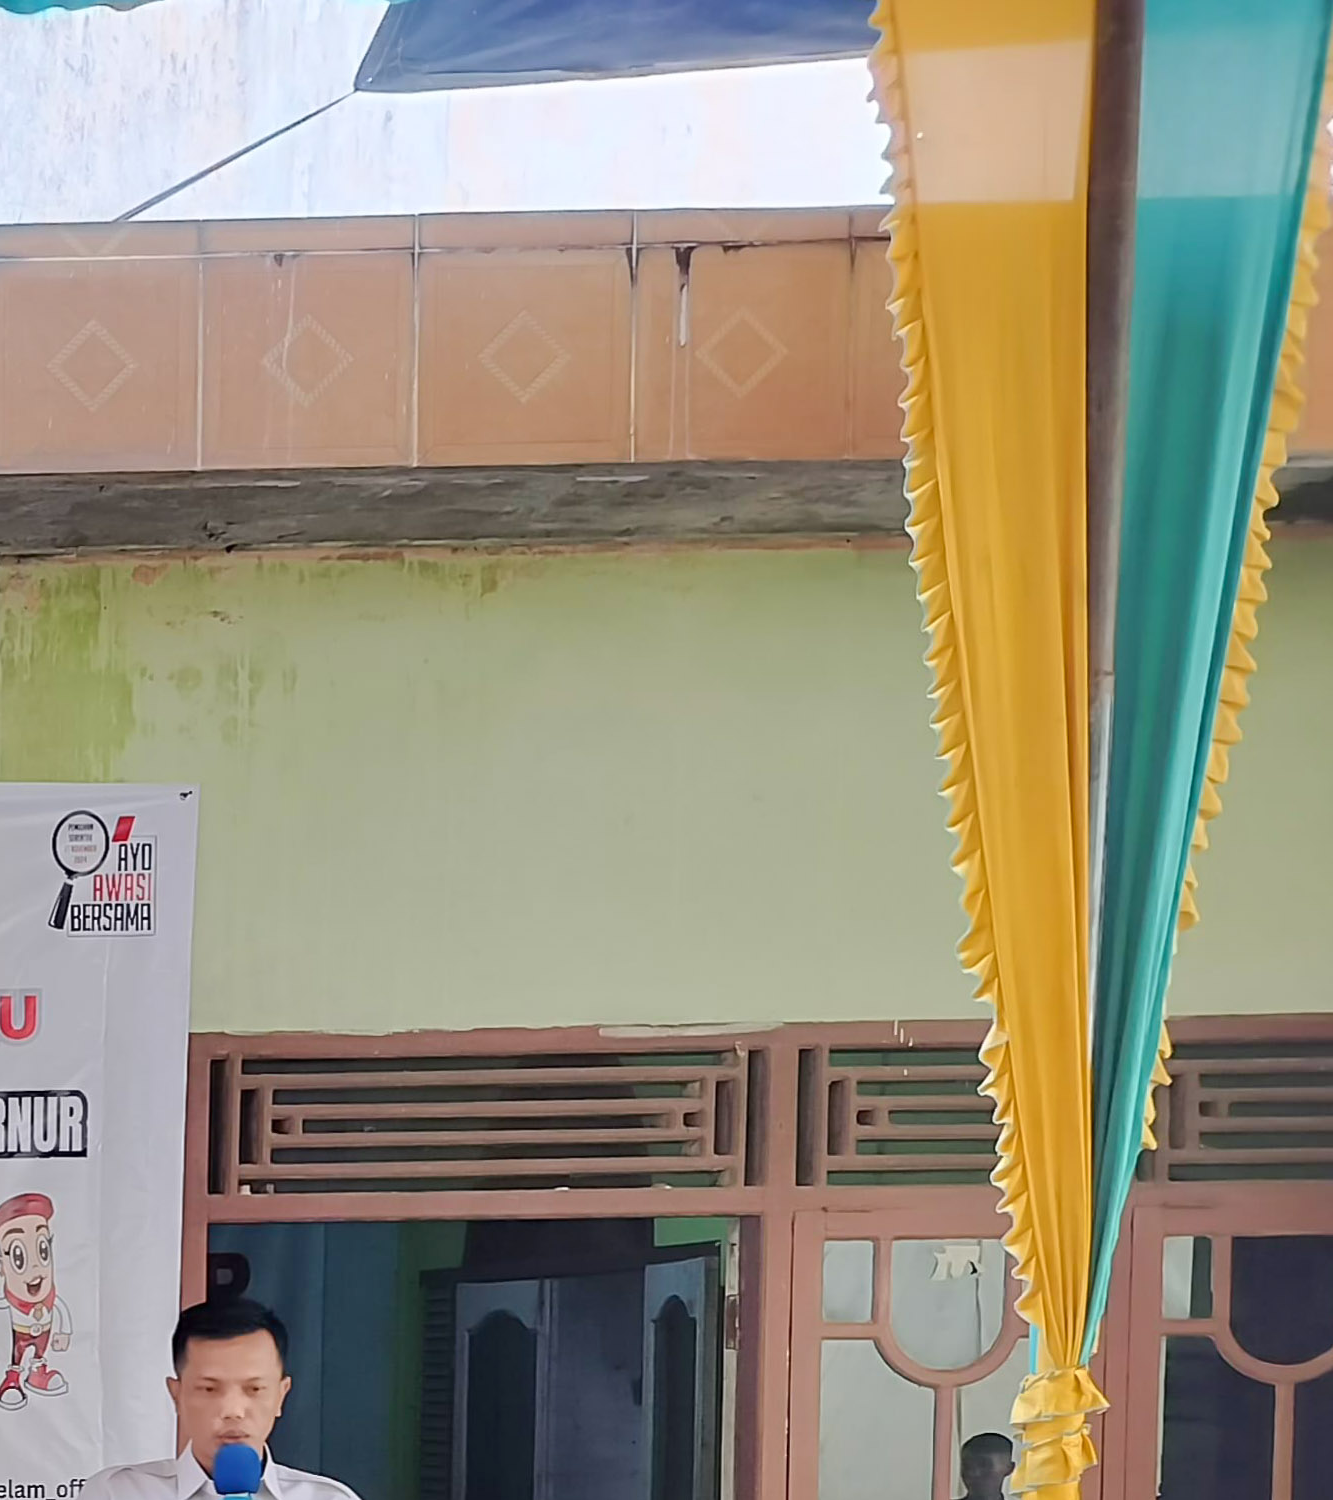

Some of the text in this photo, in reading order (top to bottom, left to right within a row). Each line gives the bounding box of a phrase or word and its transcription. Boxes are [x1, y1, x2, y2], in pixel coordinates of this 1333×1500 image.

[118, 842, 152, 872] AYO
[93, 873, 152, 902] AWASI
[70, 903, 152, 932] BERSAMA
